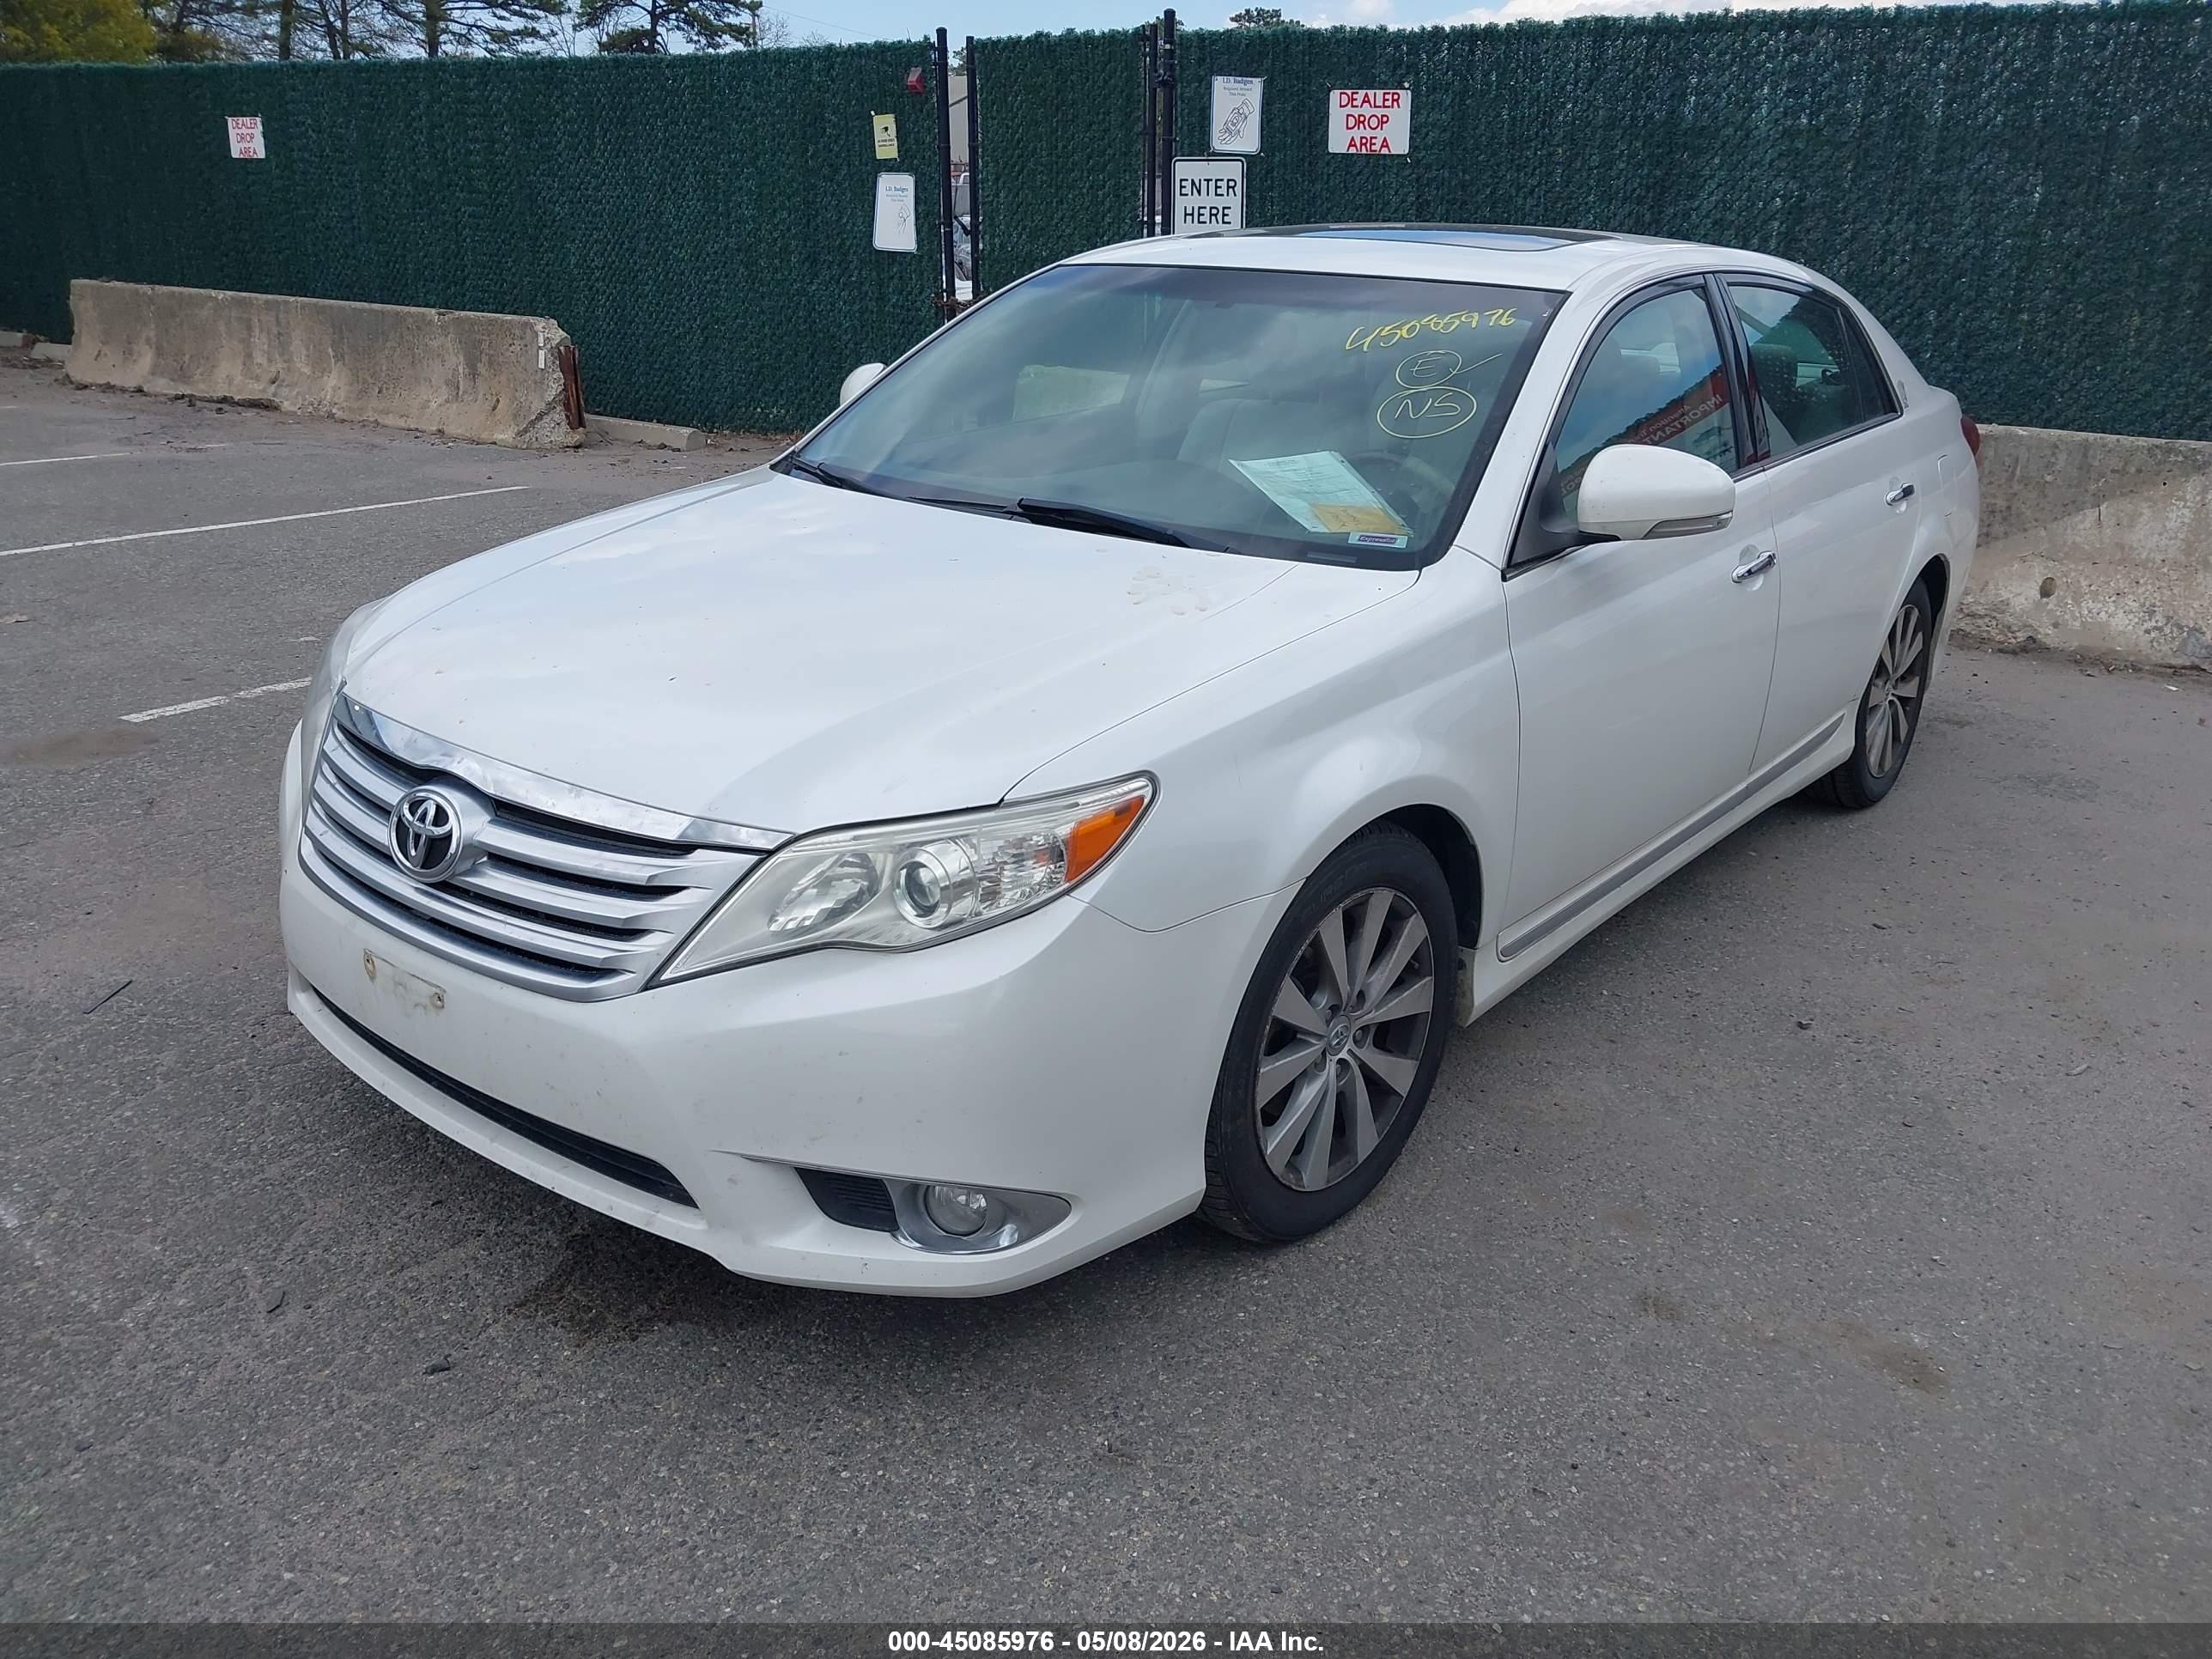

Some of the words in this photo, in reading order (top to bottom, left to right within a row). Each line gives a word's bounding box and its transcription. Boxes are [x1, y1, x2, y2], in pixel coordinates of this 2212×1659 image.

[1339, 91, 1401, 109] DEALER
[232, 118, 258, 130] DEALER
[1346, 113, 1389, 131] DROP
[236, 133, 255, 143] DROP
[1346, 136, 1392, 153] AREA
[239, 147, 258, 157] AREA
[1179, 178, 1237, 197] ENTER
[1183, 205, 1231, 224] HERE
[1410, 356, 1443, 378] E
[1395, 392, 1461, 420] NS
